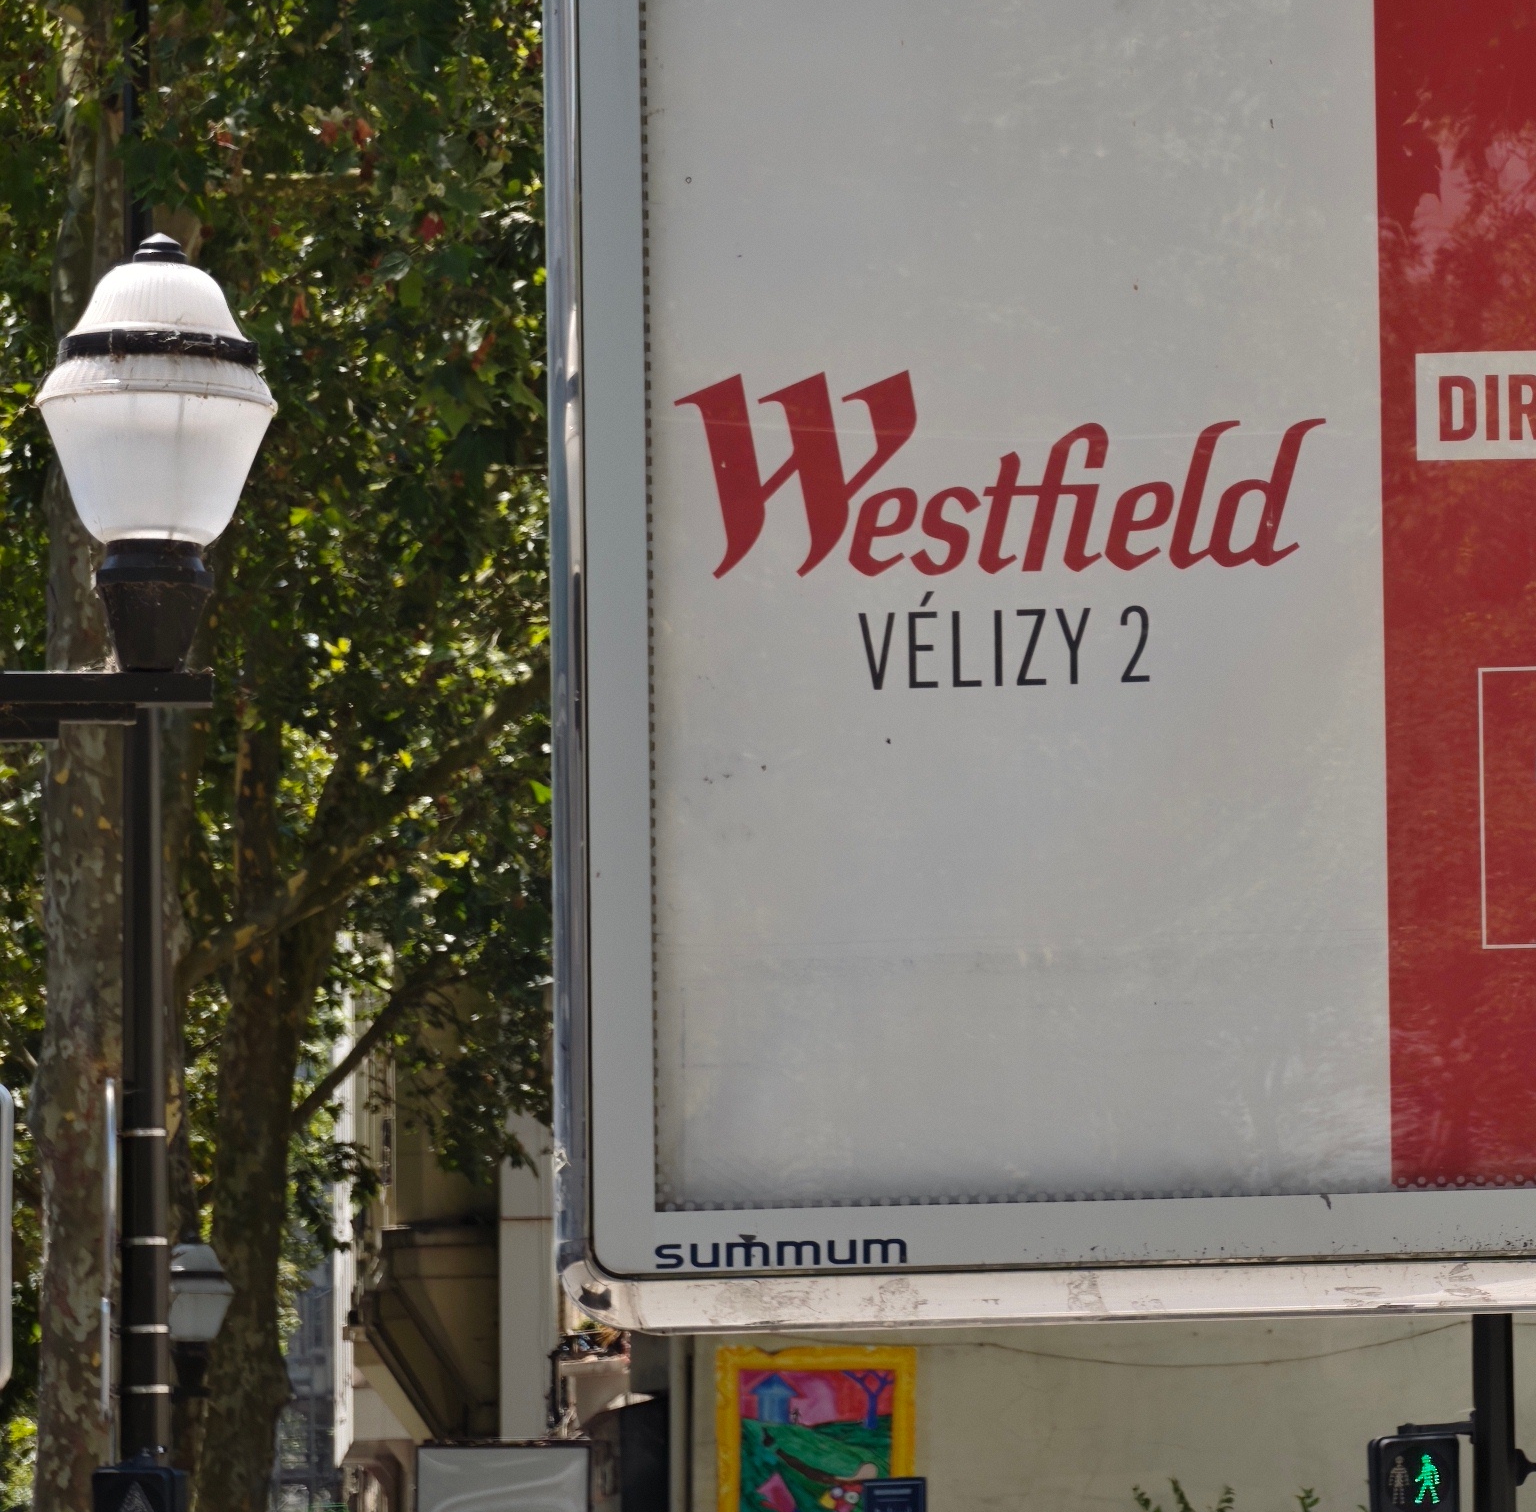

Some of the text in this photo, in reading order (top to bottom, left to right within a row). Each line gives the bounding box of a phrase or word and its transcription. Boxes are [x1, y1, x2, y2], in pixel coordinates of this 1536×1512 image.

[674, 370, 1327, 580] Westfield
[858, 590, 1151, 691] VÉLIZY 2
[655, 1237, 908, 1270] summum
